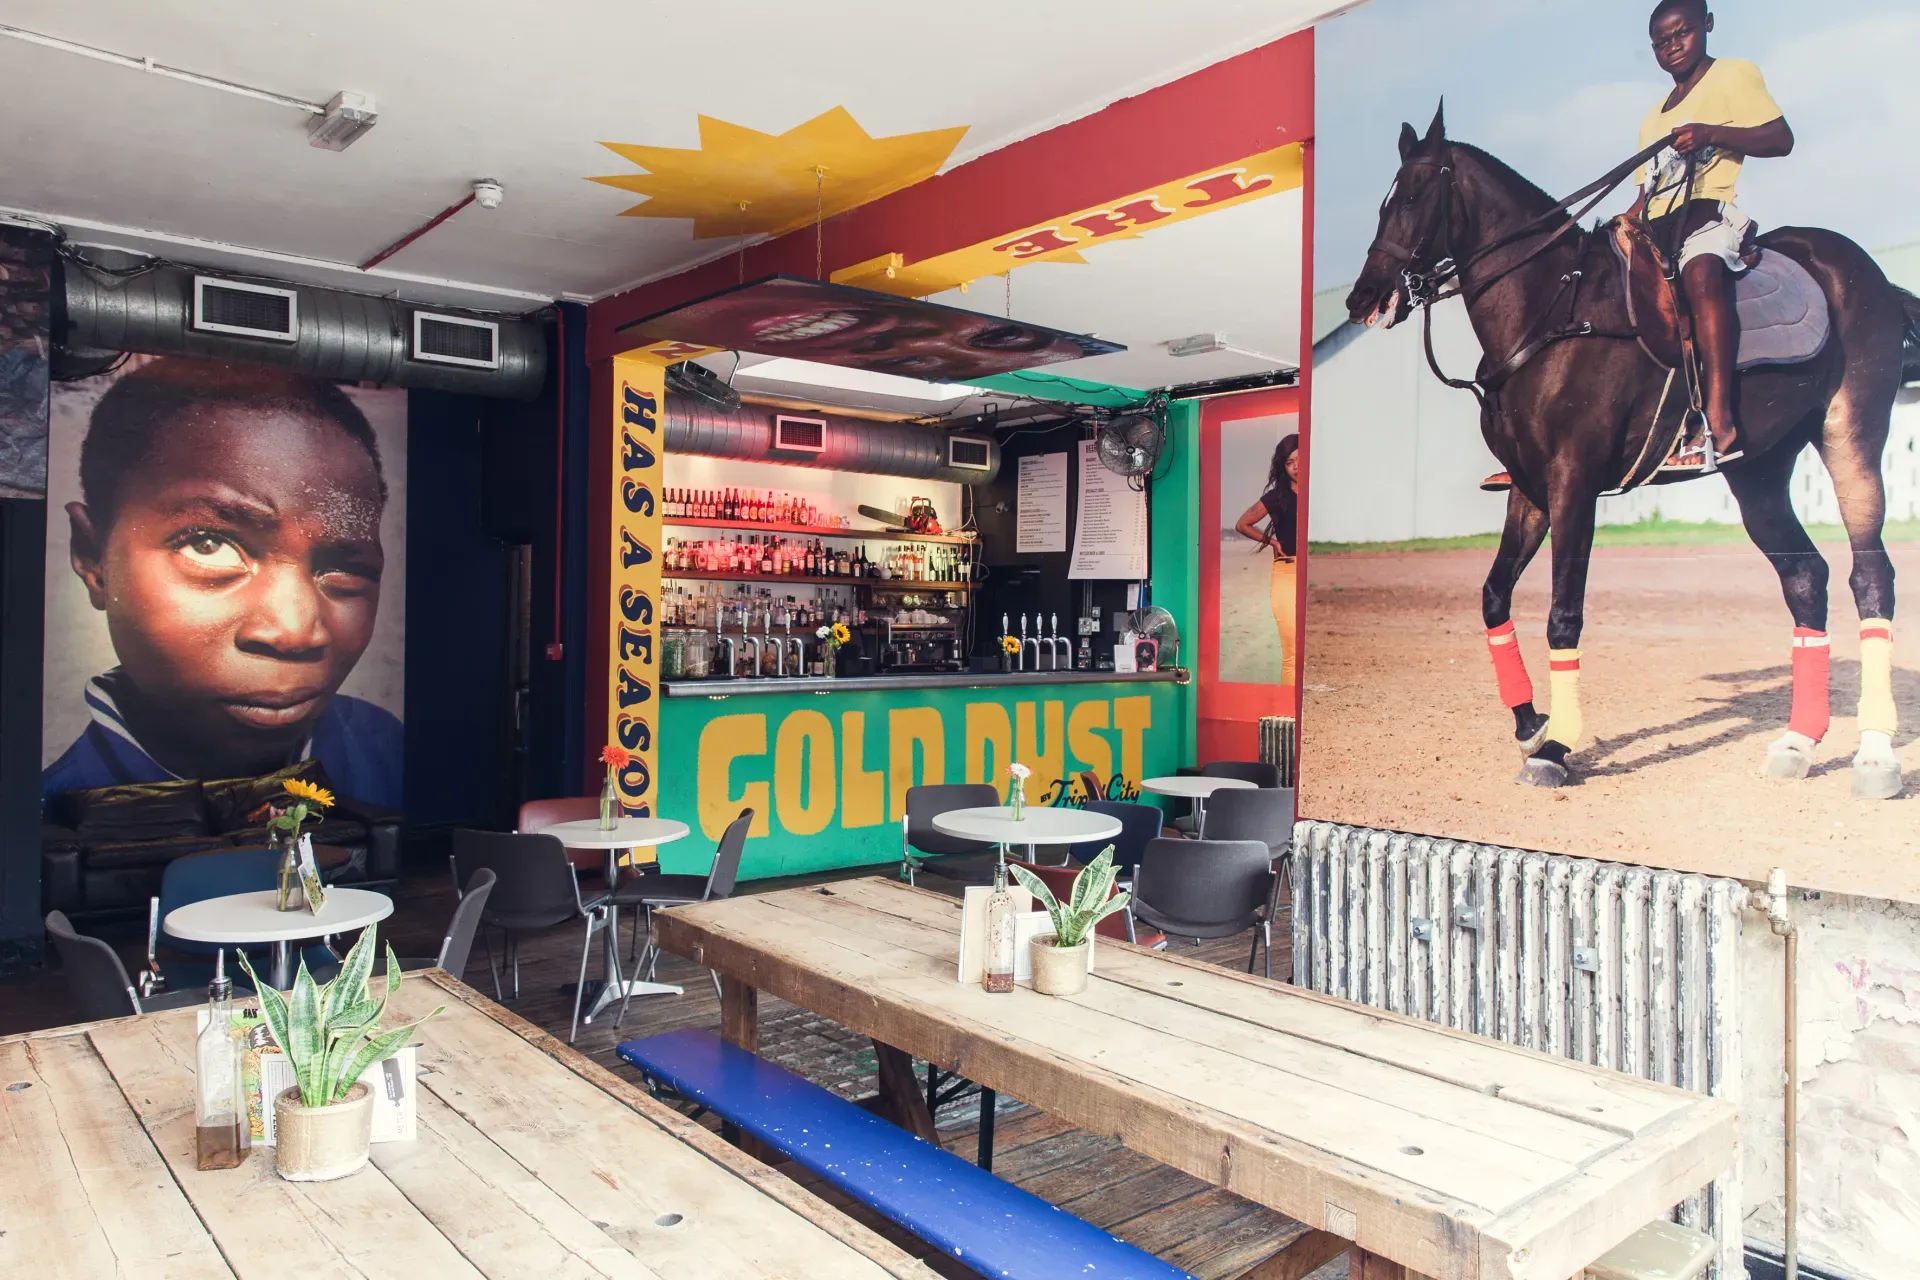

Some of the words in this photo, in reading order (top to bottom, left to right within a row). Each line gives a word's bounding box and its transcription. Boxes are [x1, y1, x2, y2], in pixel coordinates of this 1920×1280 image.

[992, 166, 1274, 259] THE
[620, 380, 657, 518] HAS
[620, 525, 653, 570] A
[697, 706, 945, 843] GOLD
[965, 695, 1152, 807] DUST
[1106, 772, 1140, 804] City
